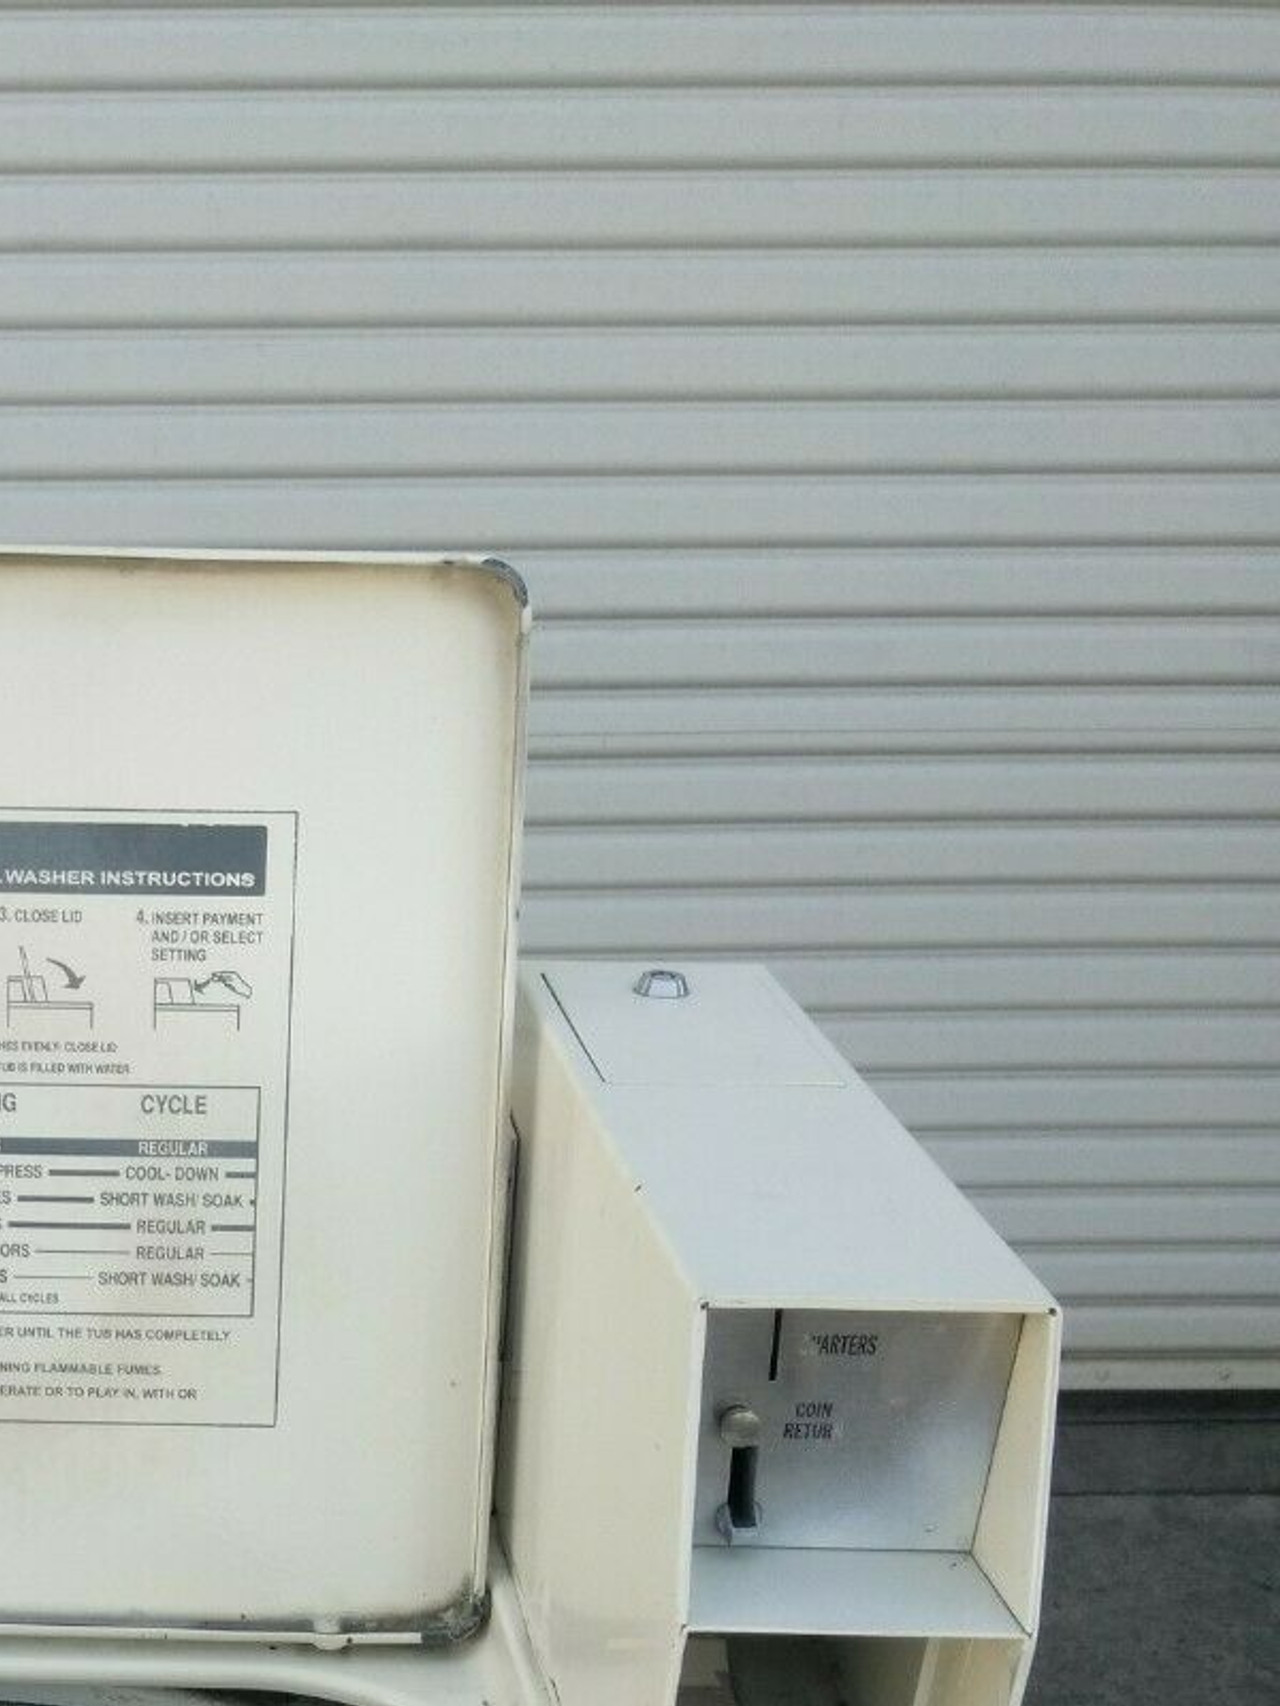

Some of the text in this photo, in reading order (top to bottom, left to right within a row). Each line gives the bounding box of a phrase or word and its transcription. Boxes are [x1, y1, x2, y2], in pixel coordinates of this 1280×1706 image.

[4, 869, 255, 887] WASHER INSTRUCTIONS
[14, 908, 58, 922] CLOSE
[62, 909, 82, 923] LID
[136, 910, 263, 926] 4. INSERT PAYMENT
[213, 931, 263, 945] SELECT
[152, 949, 206, 962] SETTING
[140, 1095, 207, 1115] CYCLE
[138, 1140, 208, 1156] REGULAR
[100, 1192, 151, 1207] SHORT
[136, 1220, 206, 1235] REGULAR
[136, 1246, 205, 1261] REGULAR
[98, 1271, 148, 1286] SHORT
[17, 1326, 53, 1338] UNTIL
[58, 1327, 82, 1339] THE
[115, 1328, 142, 1340] HAS
[145, 1328, 231, 1341] COMPLETELY
[34, 1363, 112, 1375] FLAMMABLE
[45, 1386, 63, 1397] OR
[67, 1386, 84, 1398] TO
[88, 1386, 119, 1398] PLAY
[143, 1388, 174, 1400] WITH
[178, 1388, 197, 1400] OR
[796, 1402, 834, 1418] COIN
